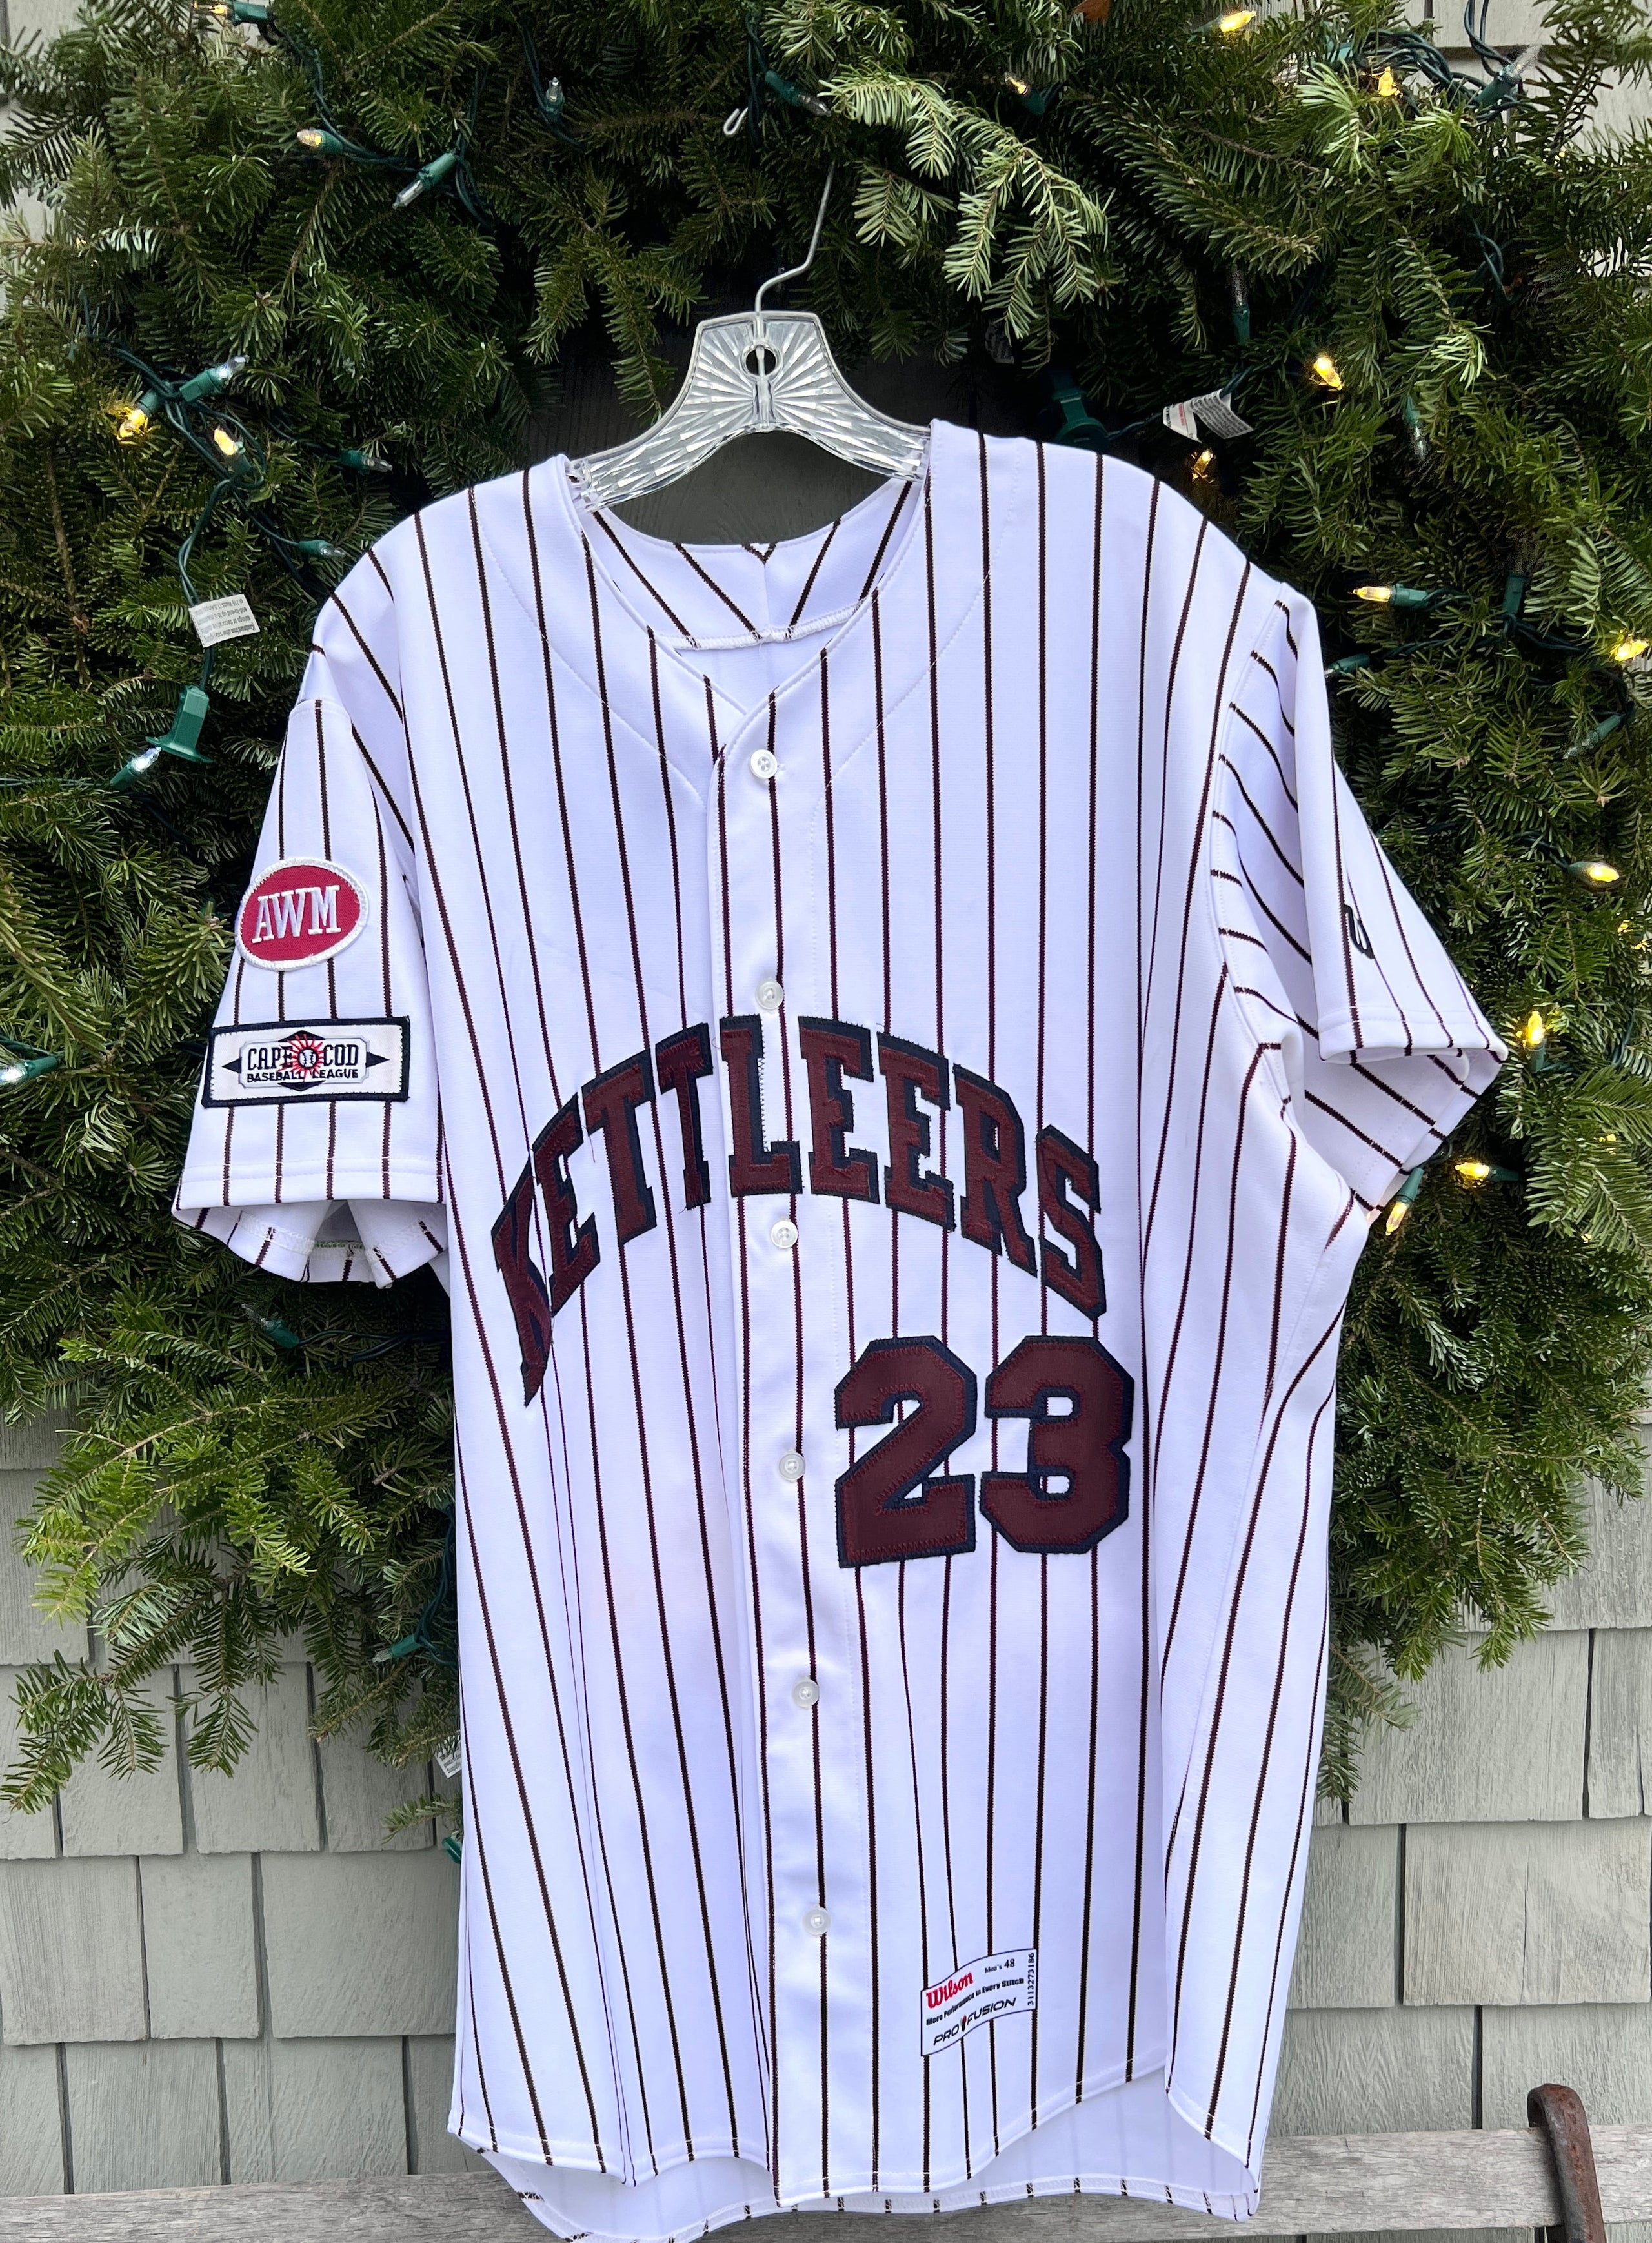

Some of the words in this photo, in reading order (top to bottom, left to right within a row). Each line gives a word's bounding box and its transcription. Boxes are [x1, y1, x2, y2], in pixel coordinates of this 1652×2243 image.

[252, 885, 341, 944] AWM
[247, 1070, 305, 1083] BASEBALL
[312, 1068, 359, 1079] LEAGUE
[248, 1046, 293, 1071] CAPE
[323, 1044, 359, 1066] COD
[492, 1014, 1107, 1407] KETTLEERS
[834, 1335, 1134, 1568] 23
[1004, 1958, 1015, 1969] 48
[925, 1972, 974, 2009] Wilson
[926, 2014, 943, 2026] More
[982, 1982, 1001, 1994] Every
[1002, 1978, 1024, 1988] Stitch
[933, 2024, 960, 2046] PRO
[967, 1996, 1017, 2025] FUSION
